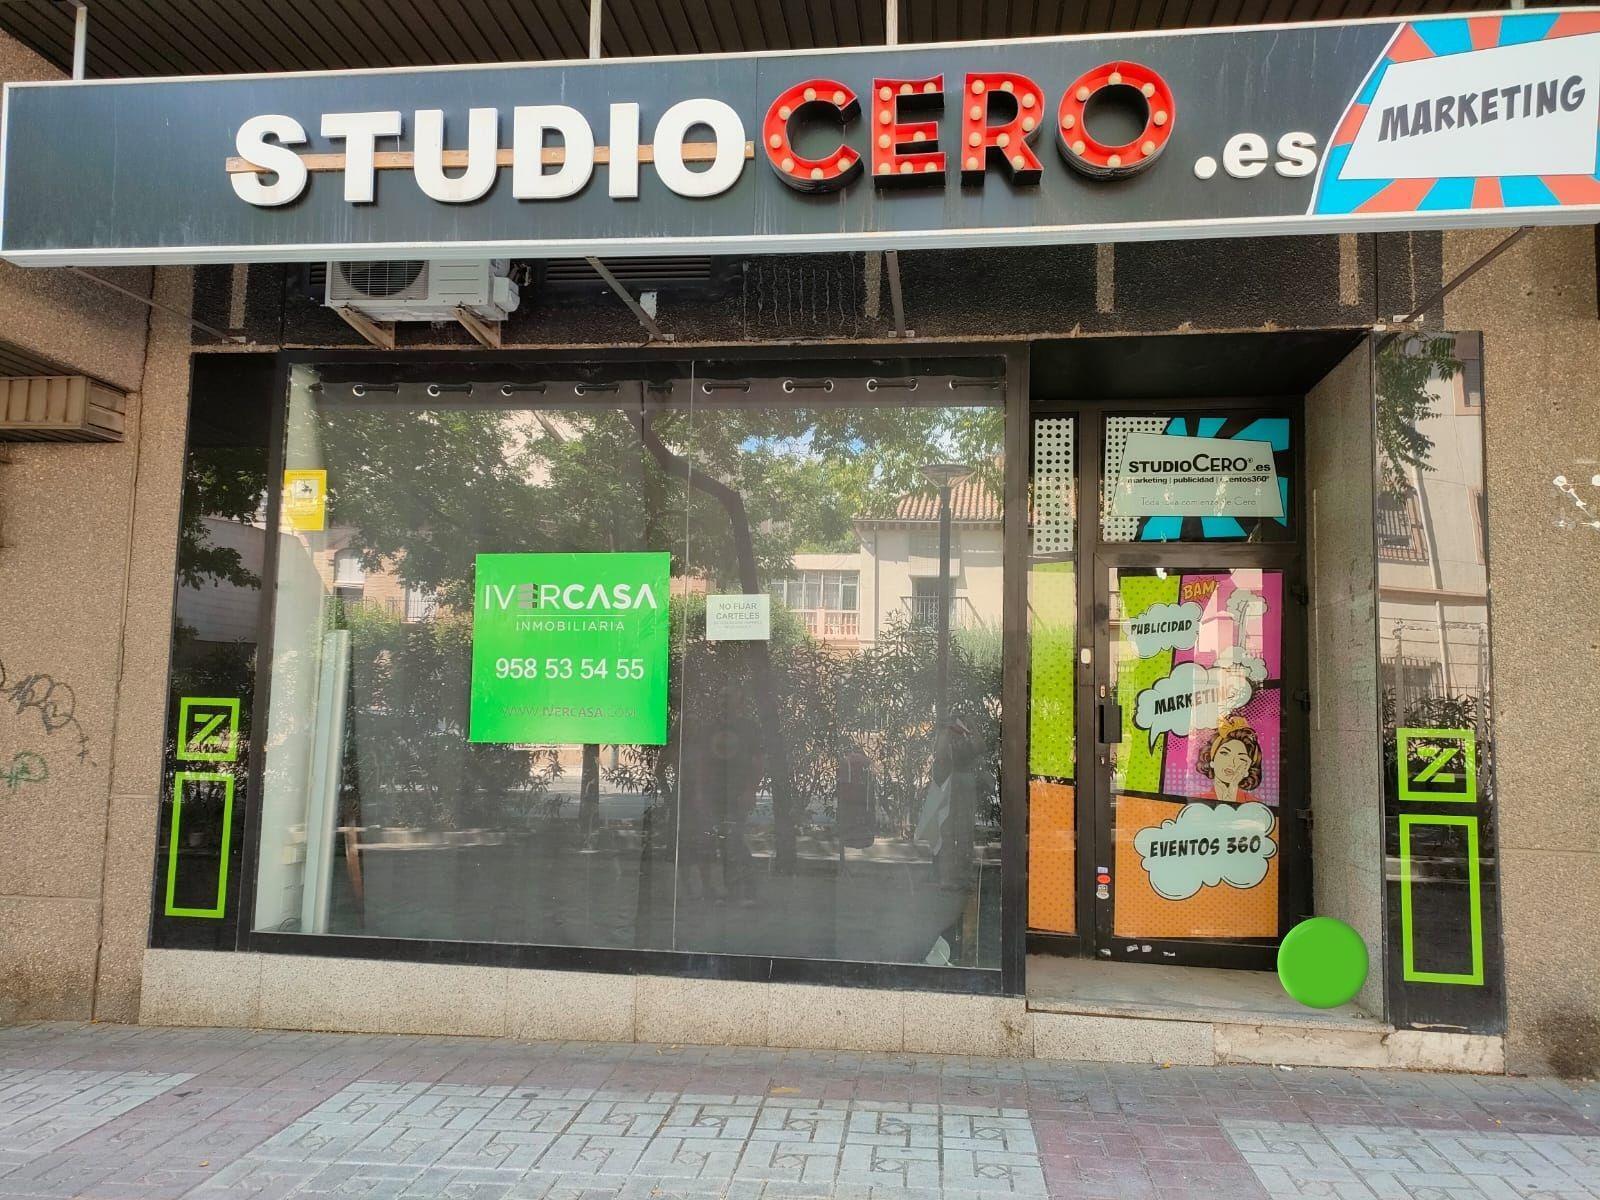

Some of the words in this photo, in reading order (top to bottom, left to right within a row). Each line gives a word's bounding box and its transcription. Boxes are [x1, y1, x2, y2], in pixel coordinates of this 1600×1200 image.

[1378, 75, 1586, 142] MARKETING
[1173, 476, 1214, 484] publicidad
[484, 582, 658, 610] IVERCASA
[516, 620, 625, 632] INMOBILIARIA
[716, 612, 760, 620] CARTELES
[1130, 619, 1193, 636] PUBLICIDAD
[495, 657, 538, 680] 958
[545, 657, 573, 679] 53
[580, 657, 608, 679] 54
[616, 657, 645, 679] 55
[1150, 837, 1220, 858] EVENTOS
[1226, 835, 1262, 855] 360
